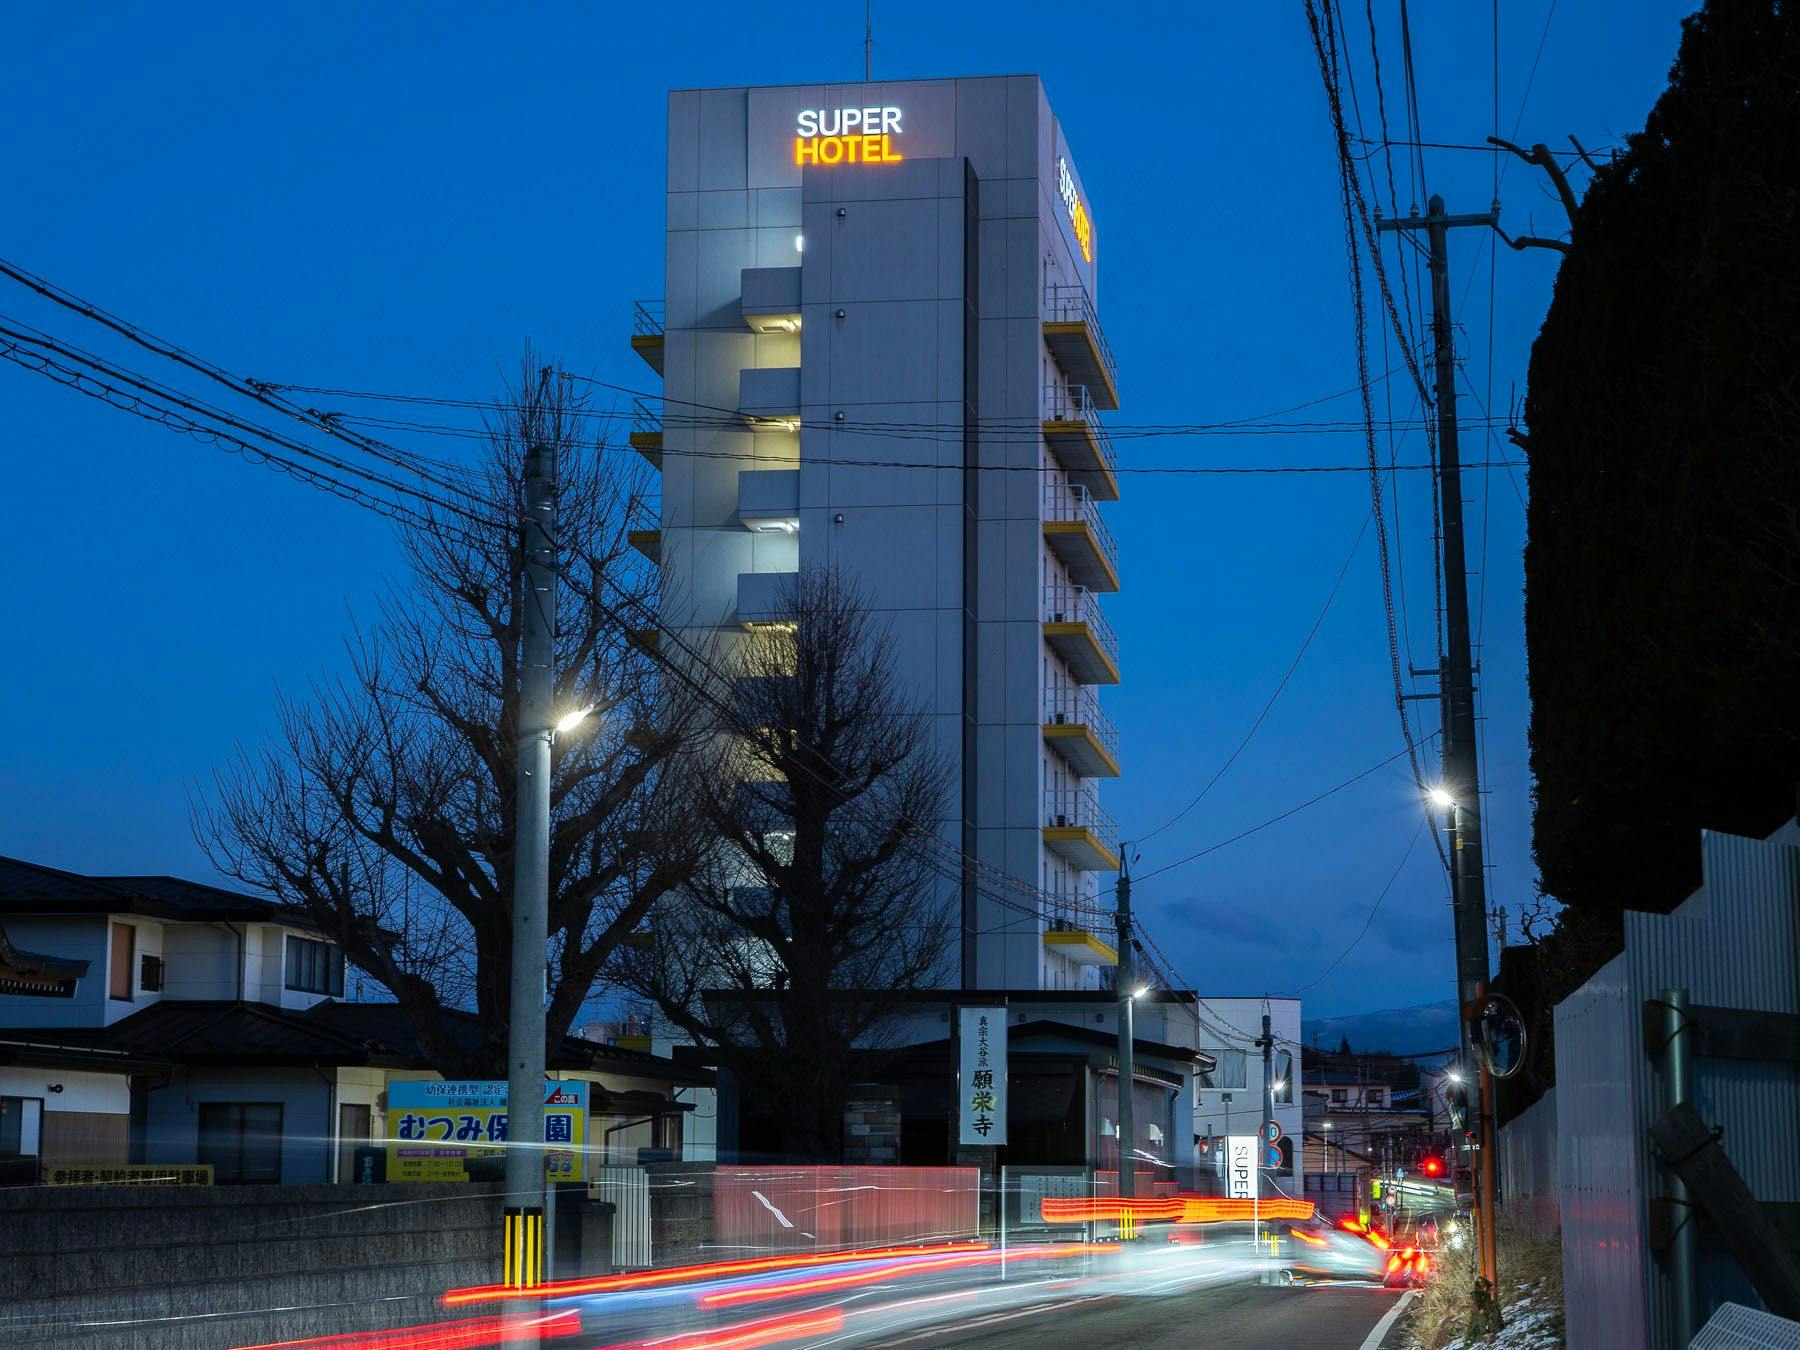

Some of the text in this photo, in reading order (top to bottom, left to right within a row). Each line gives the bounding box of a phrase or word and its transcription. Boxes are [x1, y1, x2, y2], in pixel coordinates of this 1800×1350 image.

[797, 107, 902, 137] SUPER
[796, 135, 902, 164] HOTEL
[1060, 157, 1076, 220] SUPER
[977, 1015, 989, 1067] 真宗大谷派
[425, 1084, 479, 1096] 幼保連携型
[971, 1069, 994, 1137] 願栄寺
[1234, 1146, 1248, 1199] SUPER
